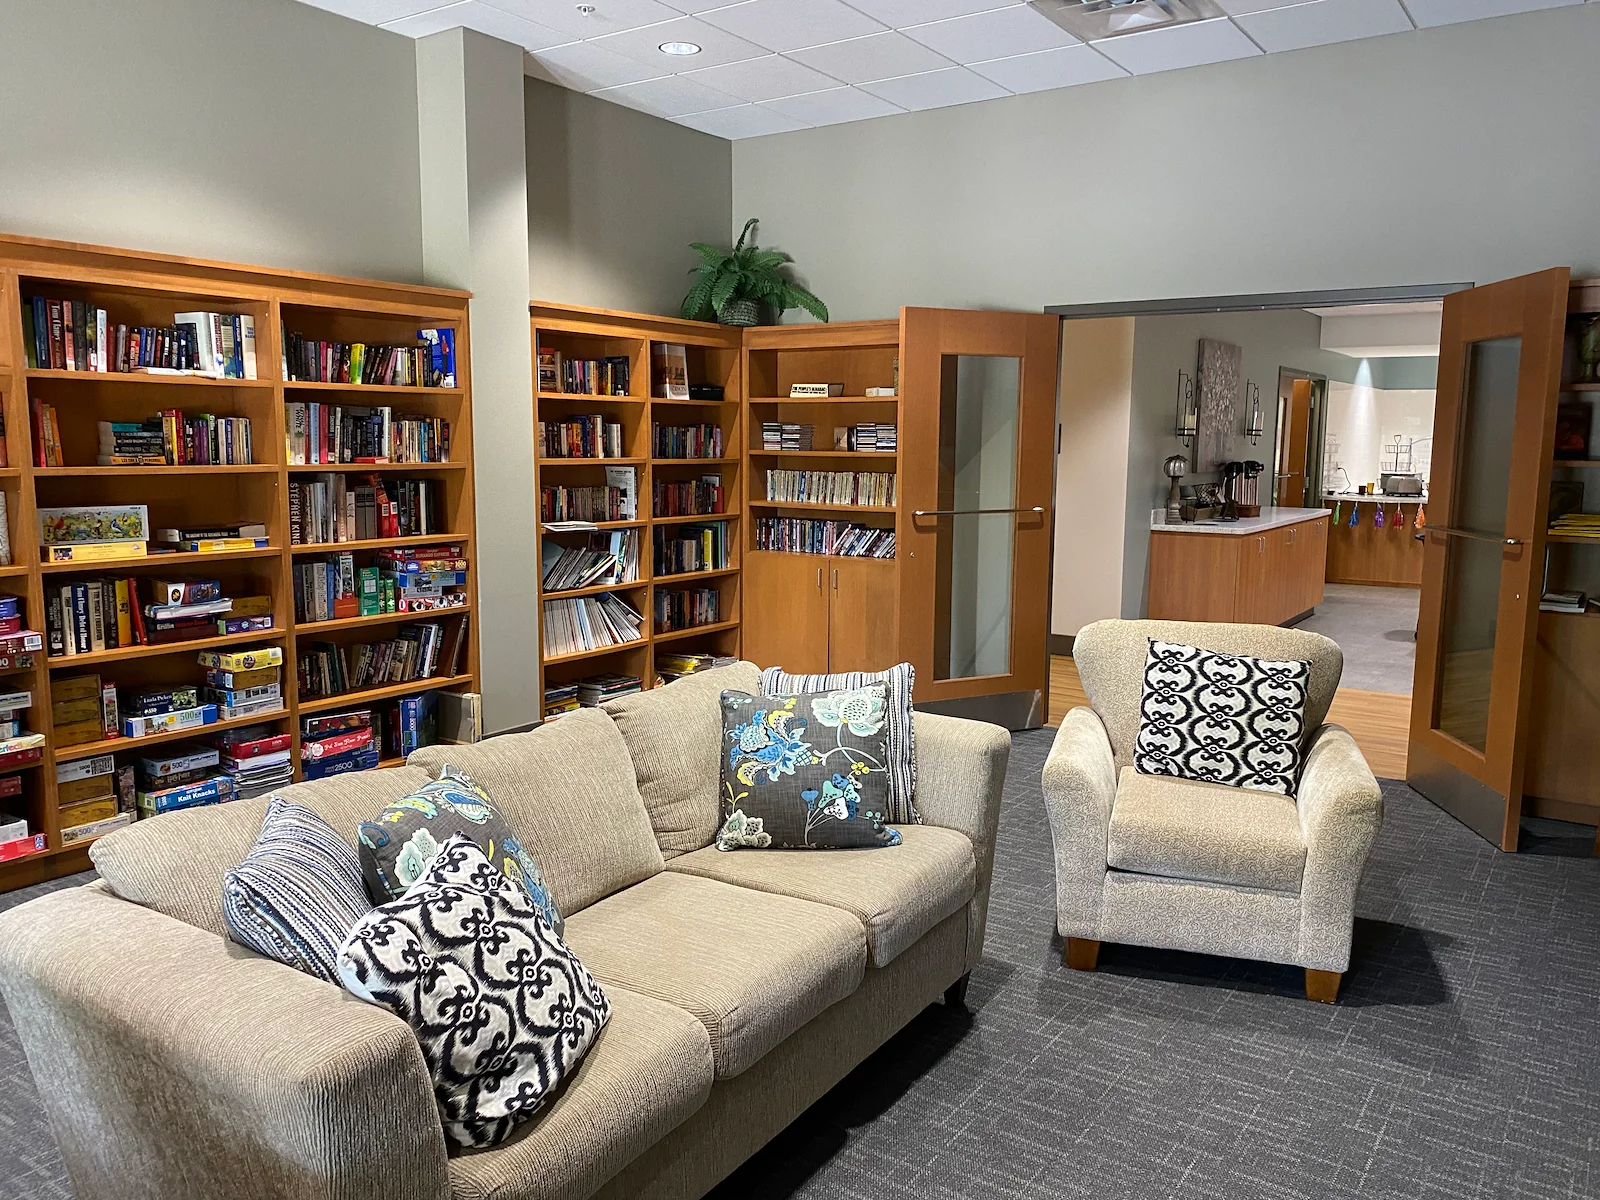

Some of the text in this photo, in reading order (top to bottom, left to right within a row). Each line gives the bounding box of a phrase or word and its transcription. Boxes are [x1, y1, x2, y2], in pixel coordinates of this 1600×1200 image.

[289, 482, 301, 545] STEPHEN KING
[334, 761, 353, 772] 2500
[192, 789, 216, 799] Knacks
